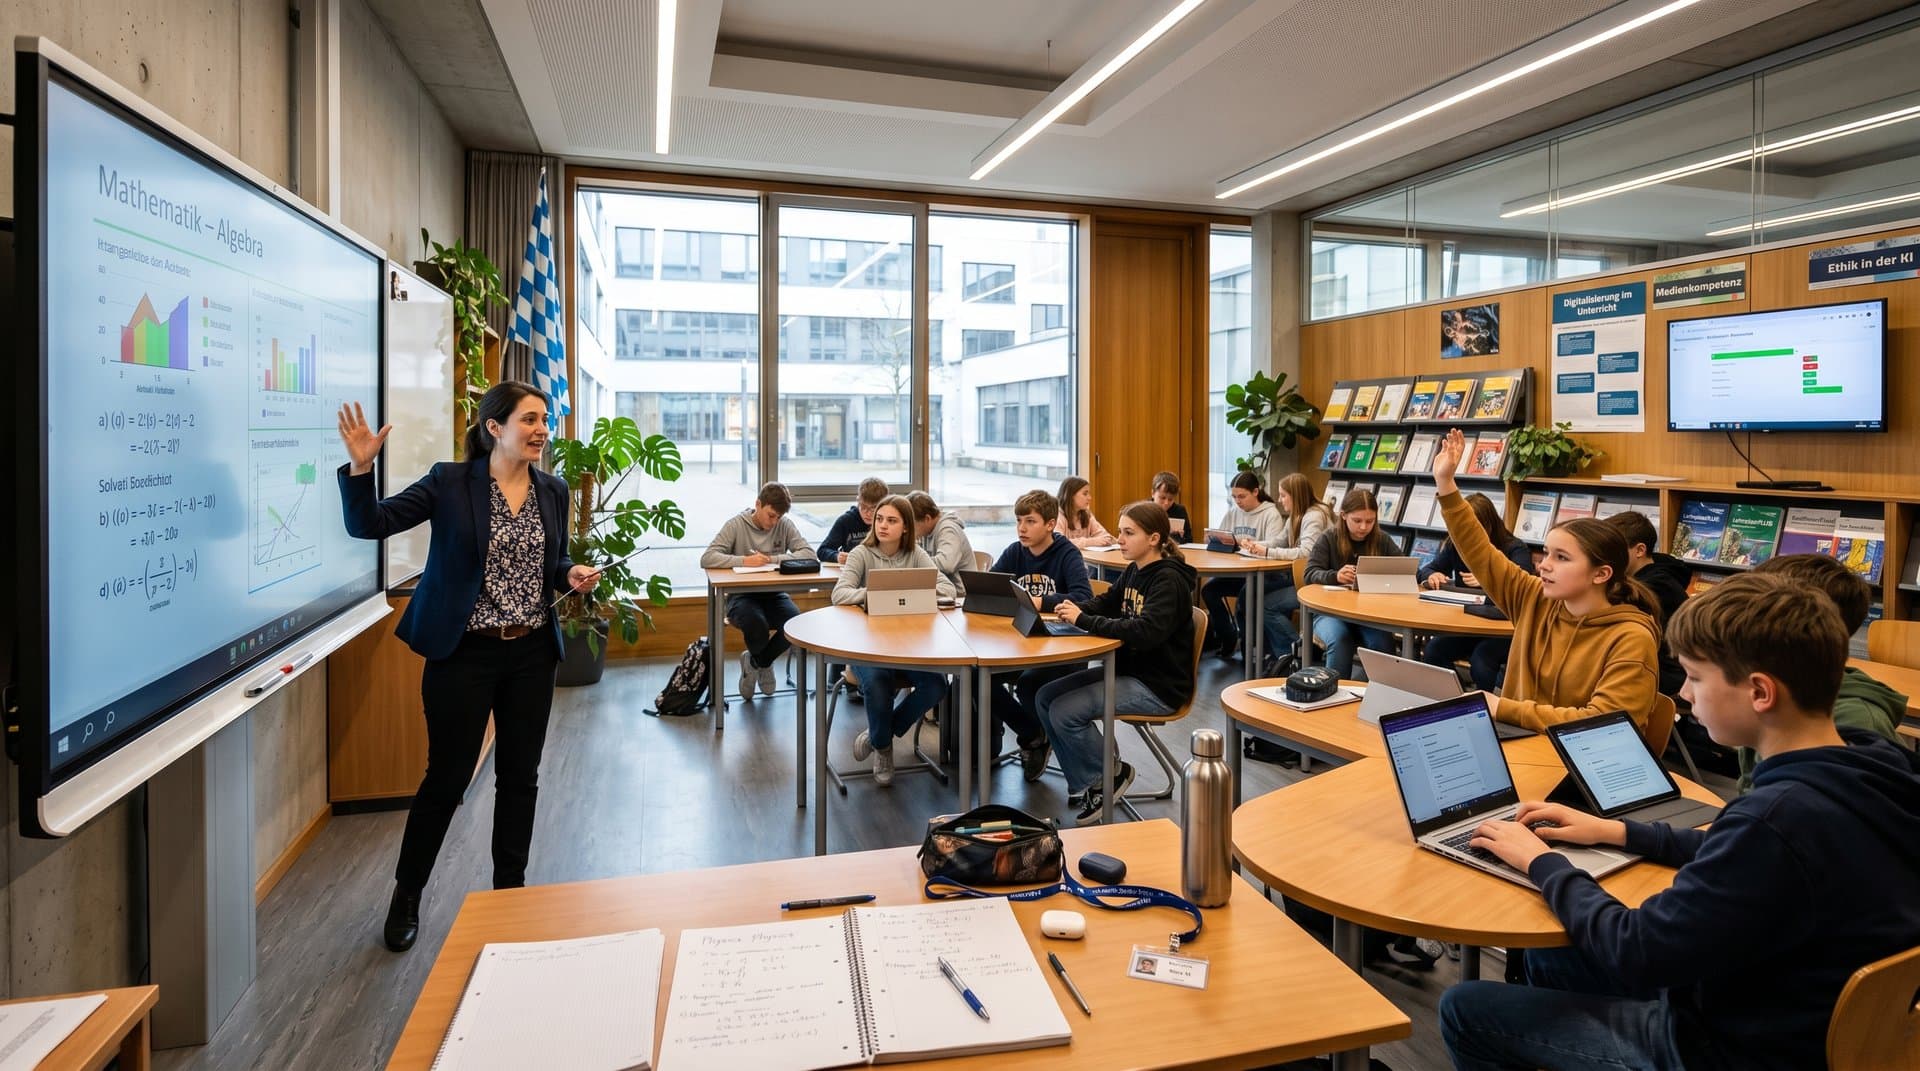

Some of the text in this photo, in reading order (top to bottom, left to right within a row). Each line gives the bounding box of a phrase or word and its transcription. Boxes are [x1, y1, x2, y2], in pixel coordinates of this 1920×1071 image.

[98, 164, 202, 235] Mathematik
[217, 218, 264, 258] Algebra
[1828, 252, 1914, 273] Ethik in der KI
[1655, 279, 1742, 297] Medienkompetenz
[1563, 291, 1632, 307] Digitalisierung im
[1577, 303, 1617, 316] Unterricht
